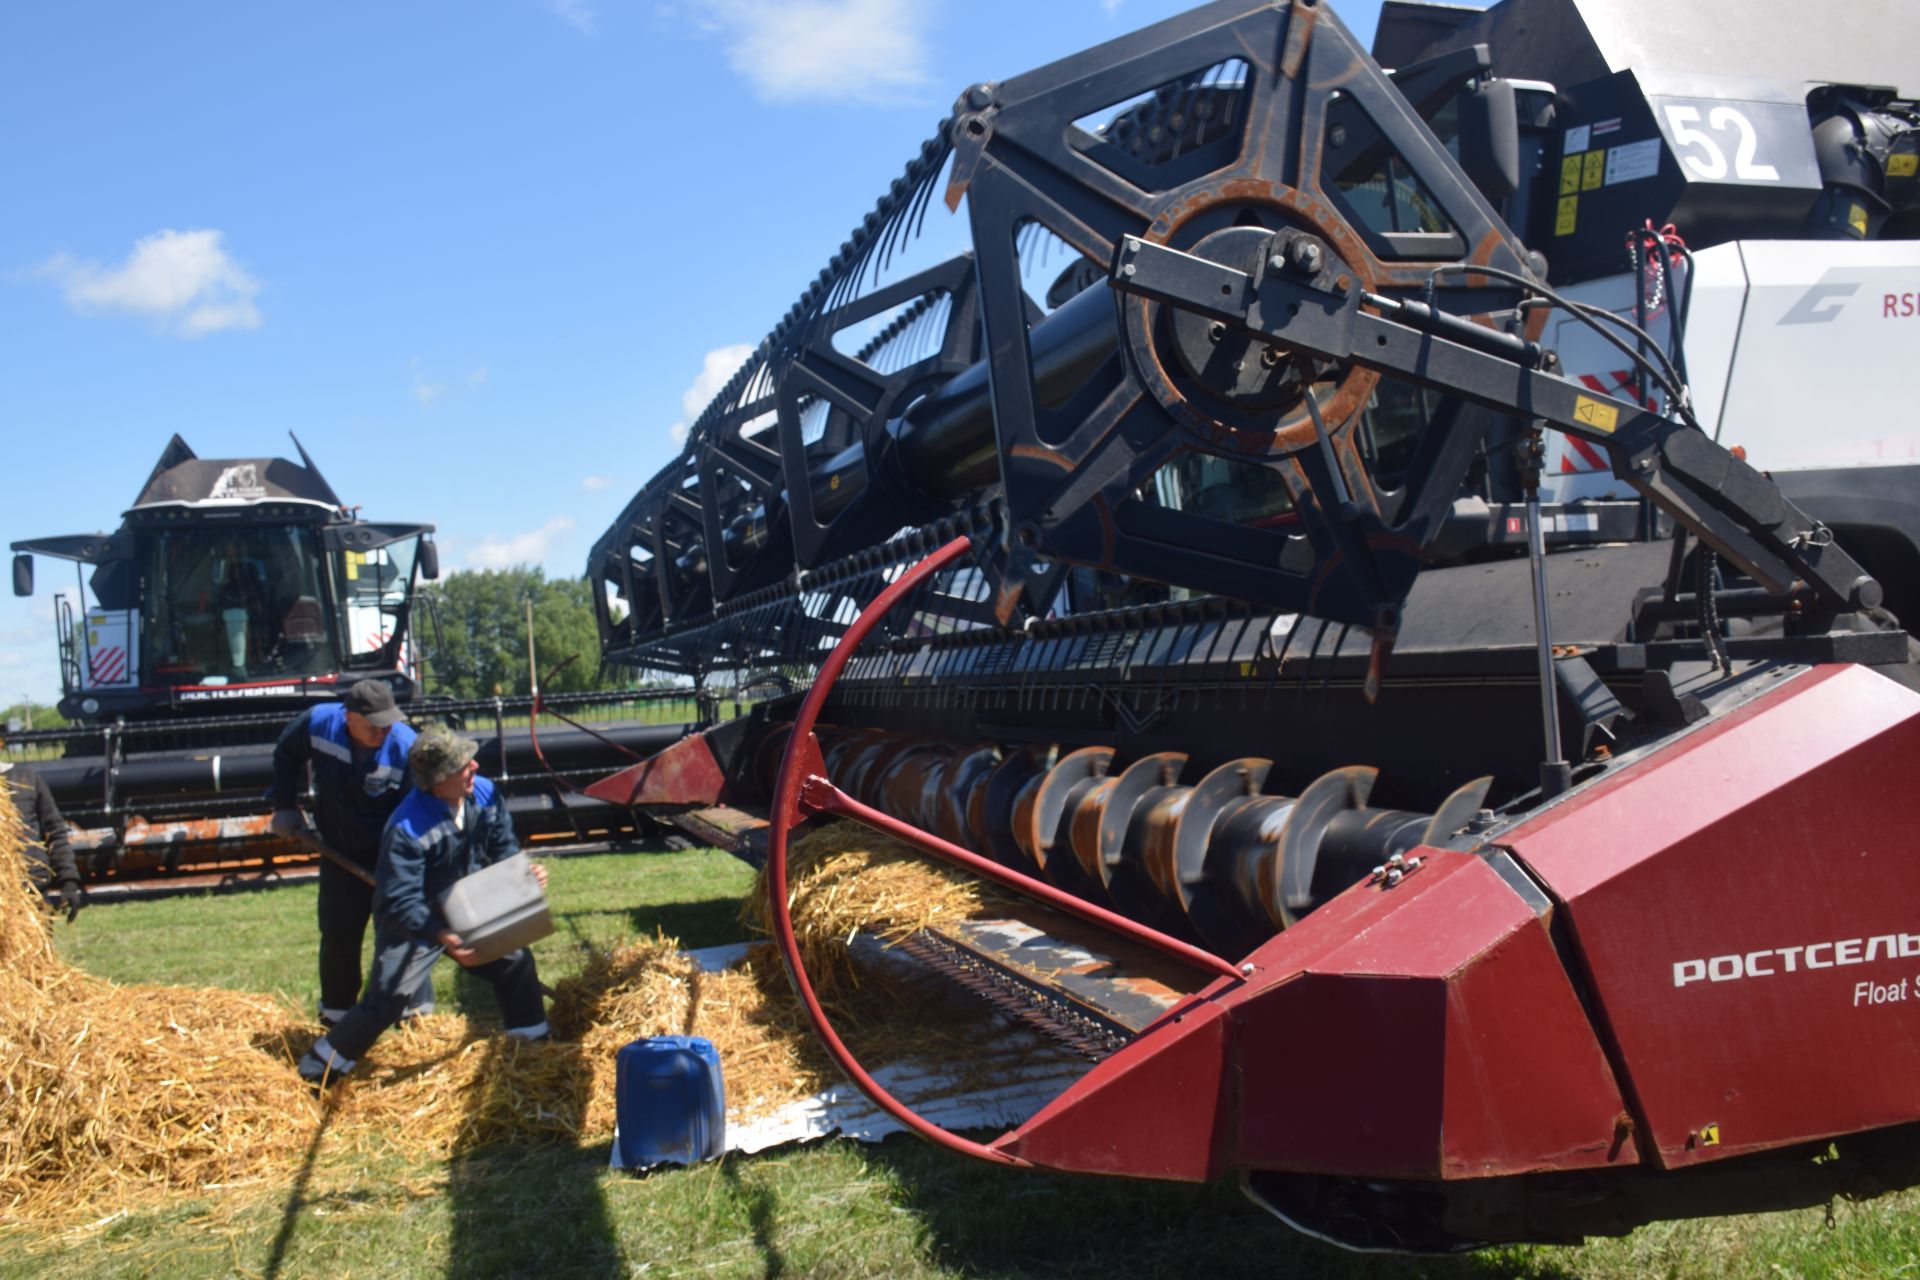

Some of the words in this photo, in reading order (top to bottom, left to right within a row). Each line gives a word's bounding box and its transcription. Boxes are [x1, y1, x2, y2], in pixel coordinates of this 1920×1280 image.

[1664, 105, 1779, 182] 52
[1883, 292, 1920, 318] RS
[1853, 977, 1908, 1007] Float
